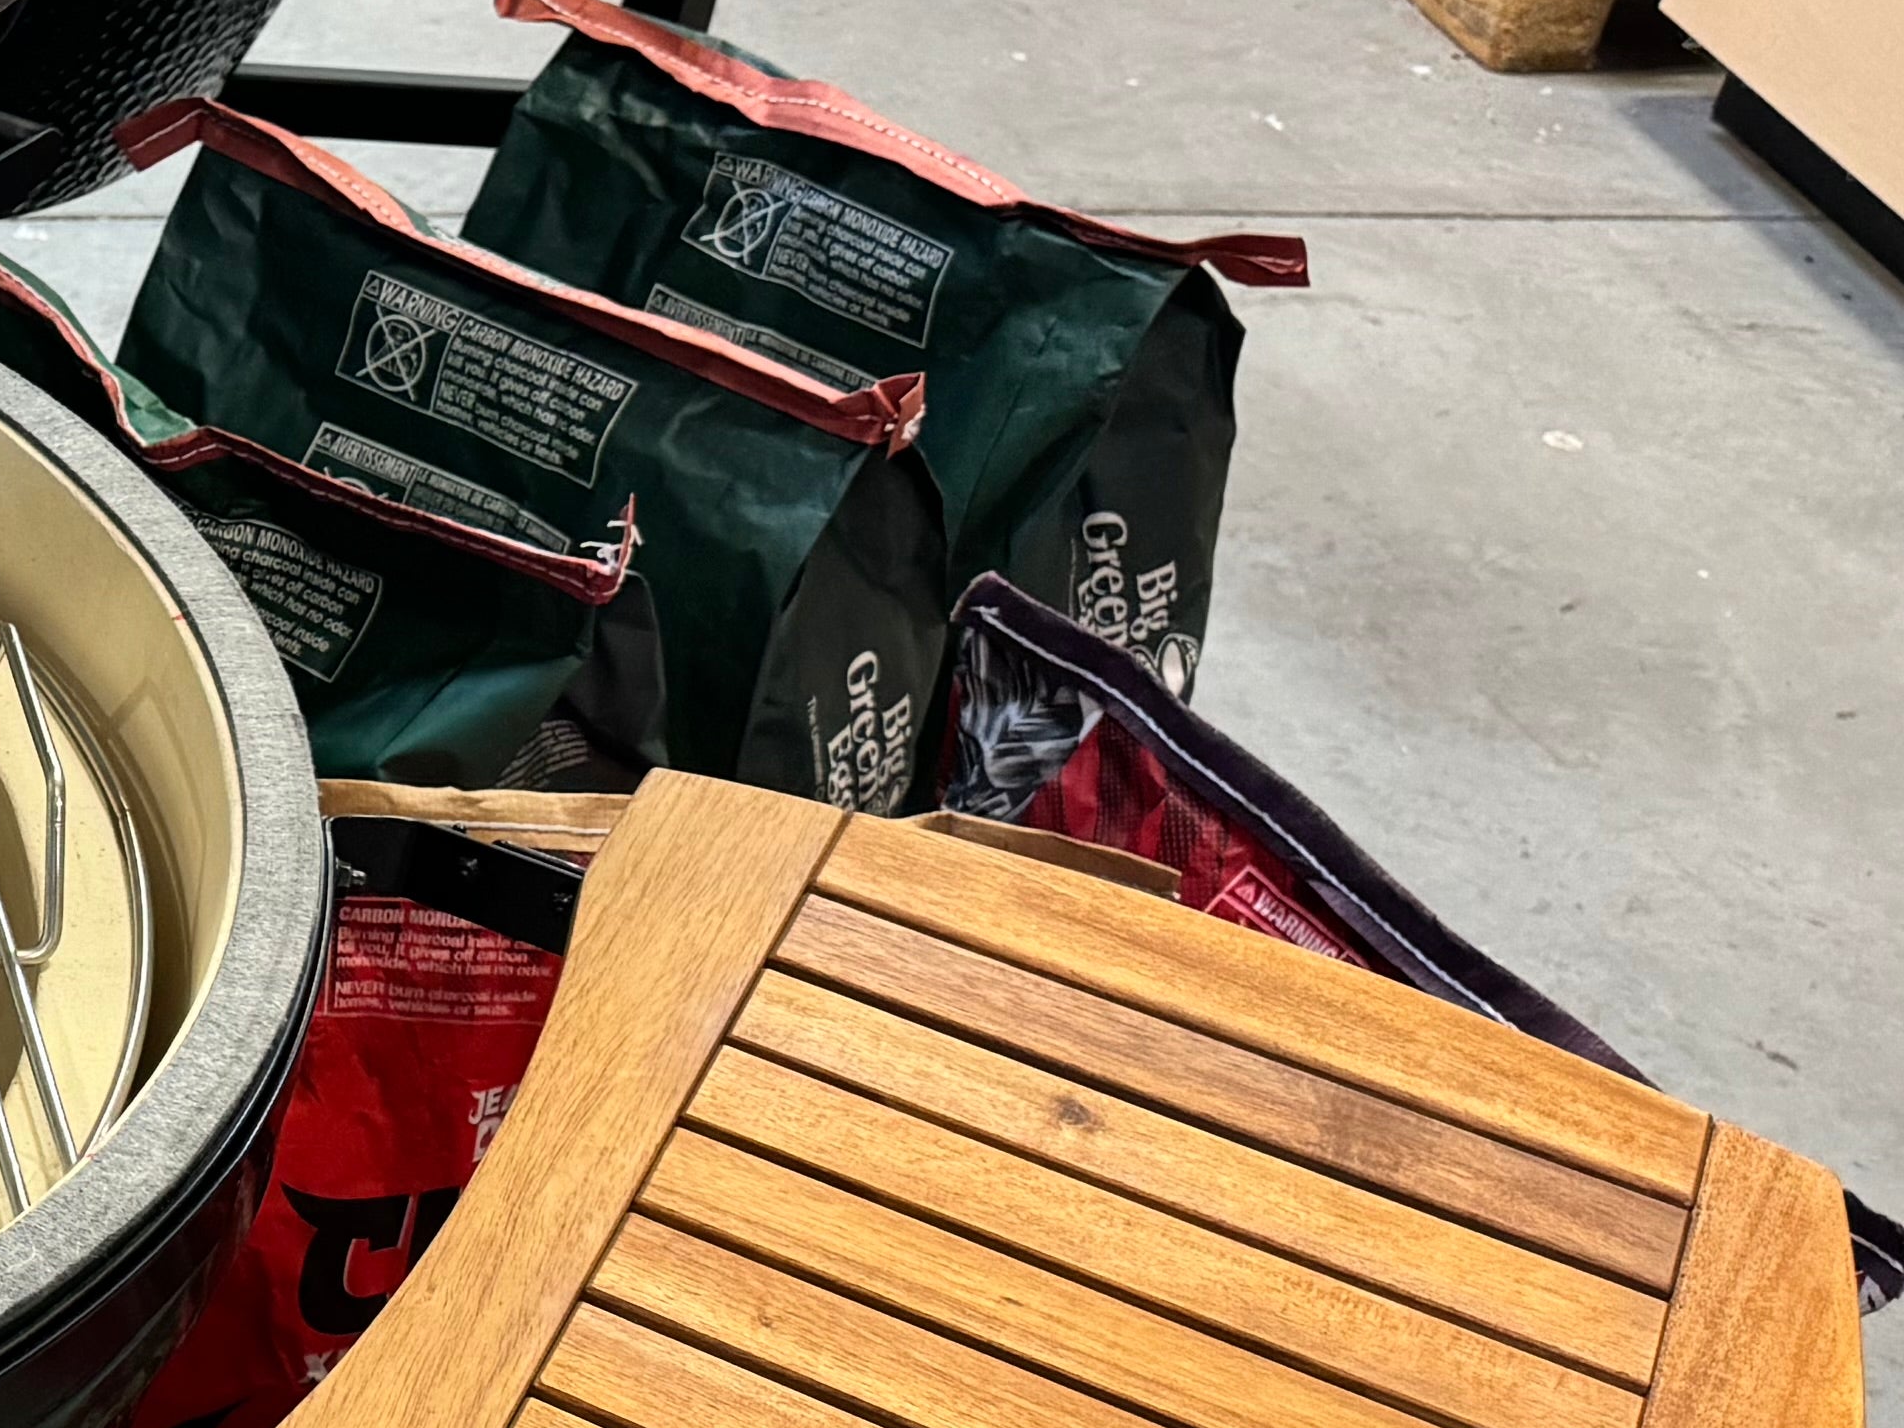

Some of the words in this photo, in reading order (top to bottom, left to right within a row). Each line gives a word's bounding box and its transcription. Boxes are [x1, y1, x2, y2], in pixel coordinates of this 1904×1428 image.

[842, 206, 902, 246] MONOXIDE
[900, 235, 944, 269] HAZARD
[380, 280, 459, 329] WARNING
[461, 319, 512, 350] CARBON
[512, 339, 574, 375] MONOXIDE
[572, 361, 626, 401] HAZARD
[1082, 511, 1128, 647] Green
[1130, 561, 1176, 640] Big
[846, 651, 880, 802] Green
[879, 693, 913, 785] Big
[339, 906, 404, 923] CARBON
[335, 981, 385, 995] NEVER
[389, 985, 423, 998] burn
